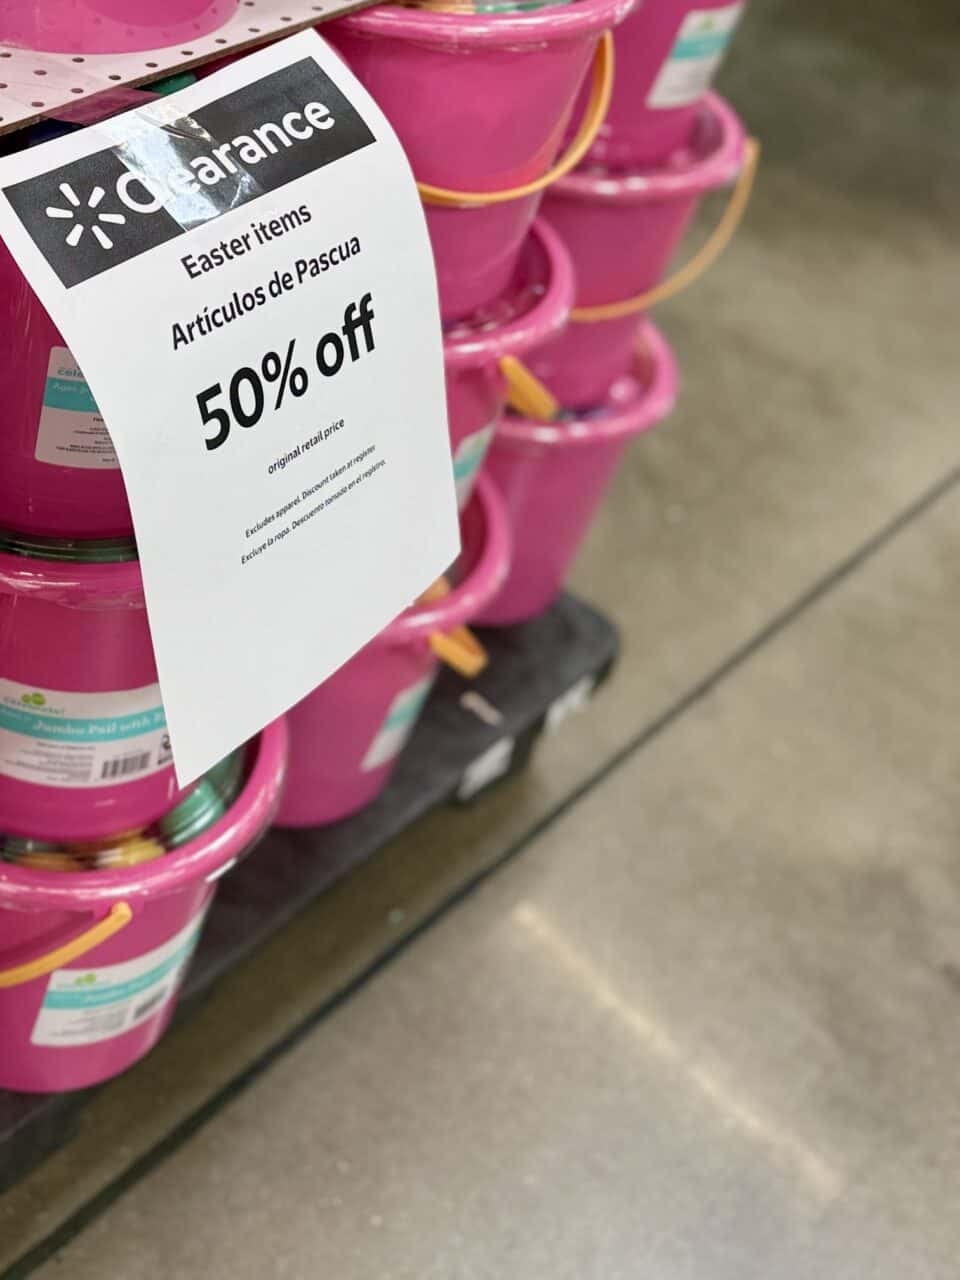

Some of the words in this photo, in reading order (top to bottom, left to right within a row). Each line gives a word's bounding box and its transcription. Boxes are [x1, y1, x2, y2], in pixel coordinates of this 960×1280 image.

[180, 232, 252, 280] Easter
[250, 204, 313, 245] items
[171, 285, 267, 351] Artículos
[268, 270, 295, 298] de
[294, 236, 362, 284] Pascua
[196, 338, 309, 451] 50%
[315, 292, 376, 377] off
[267, 445, 302, 475] original
[301, 431, 324, 454] retail
[323, 418, 345, 441] price
[240, 541, 267, 565] Excluye
[266, 536, 274, 547] la
[291, 501, 325, 530] Descuento
[324, 485, 348, 507] tomado
[244, 514, 276, 539] Excludes
[301, 476, 330, 500] Discount
[329, 465, 347, 481] taken
